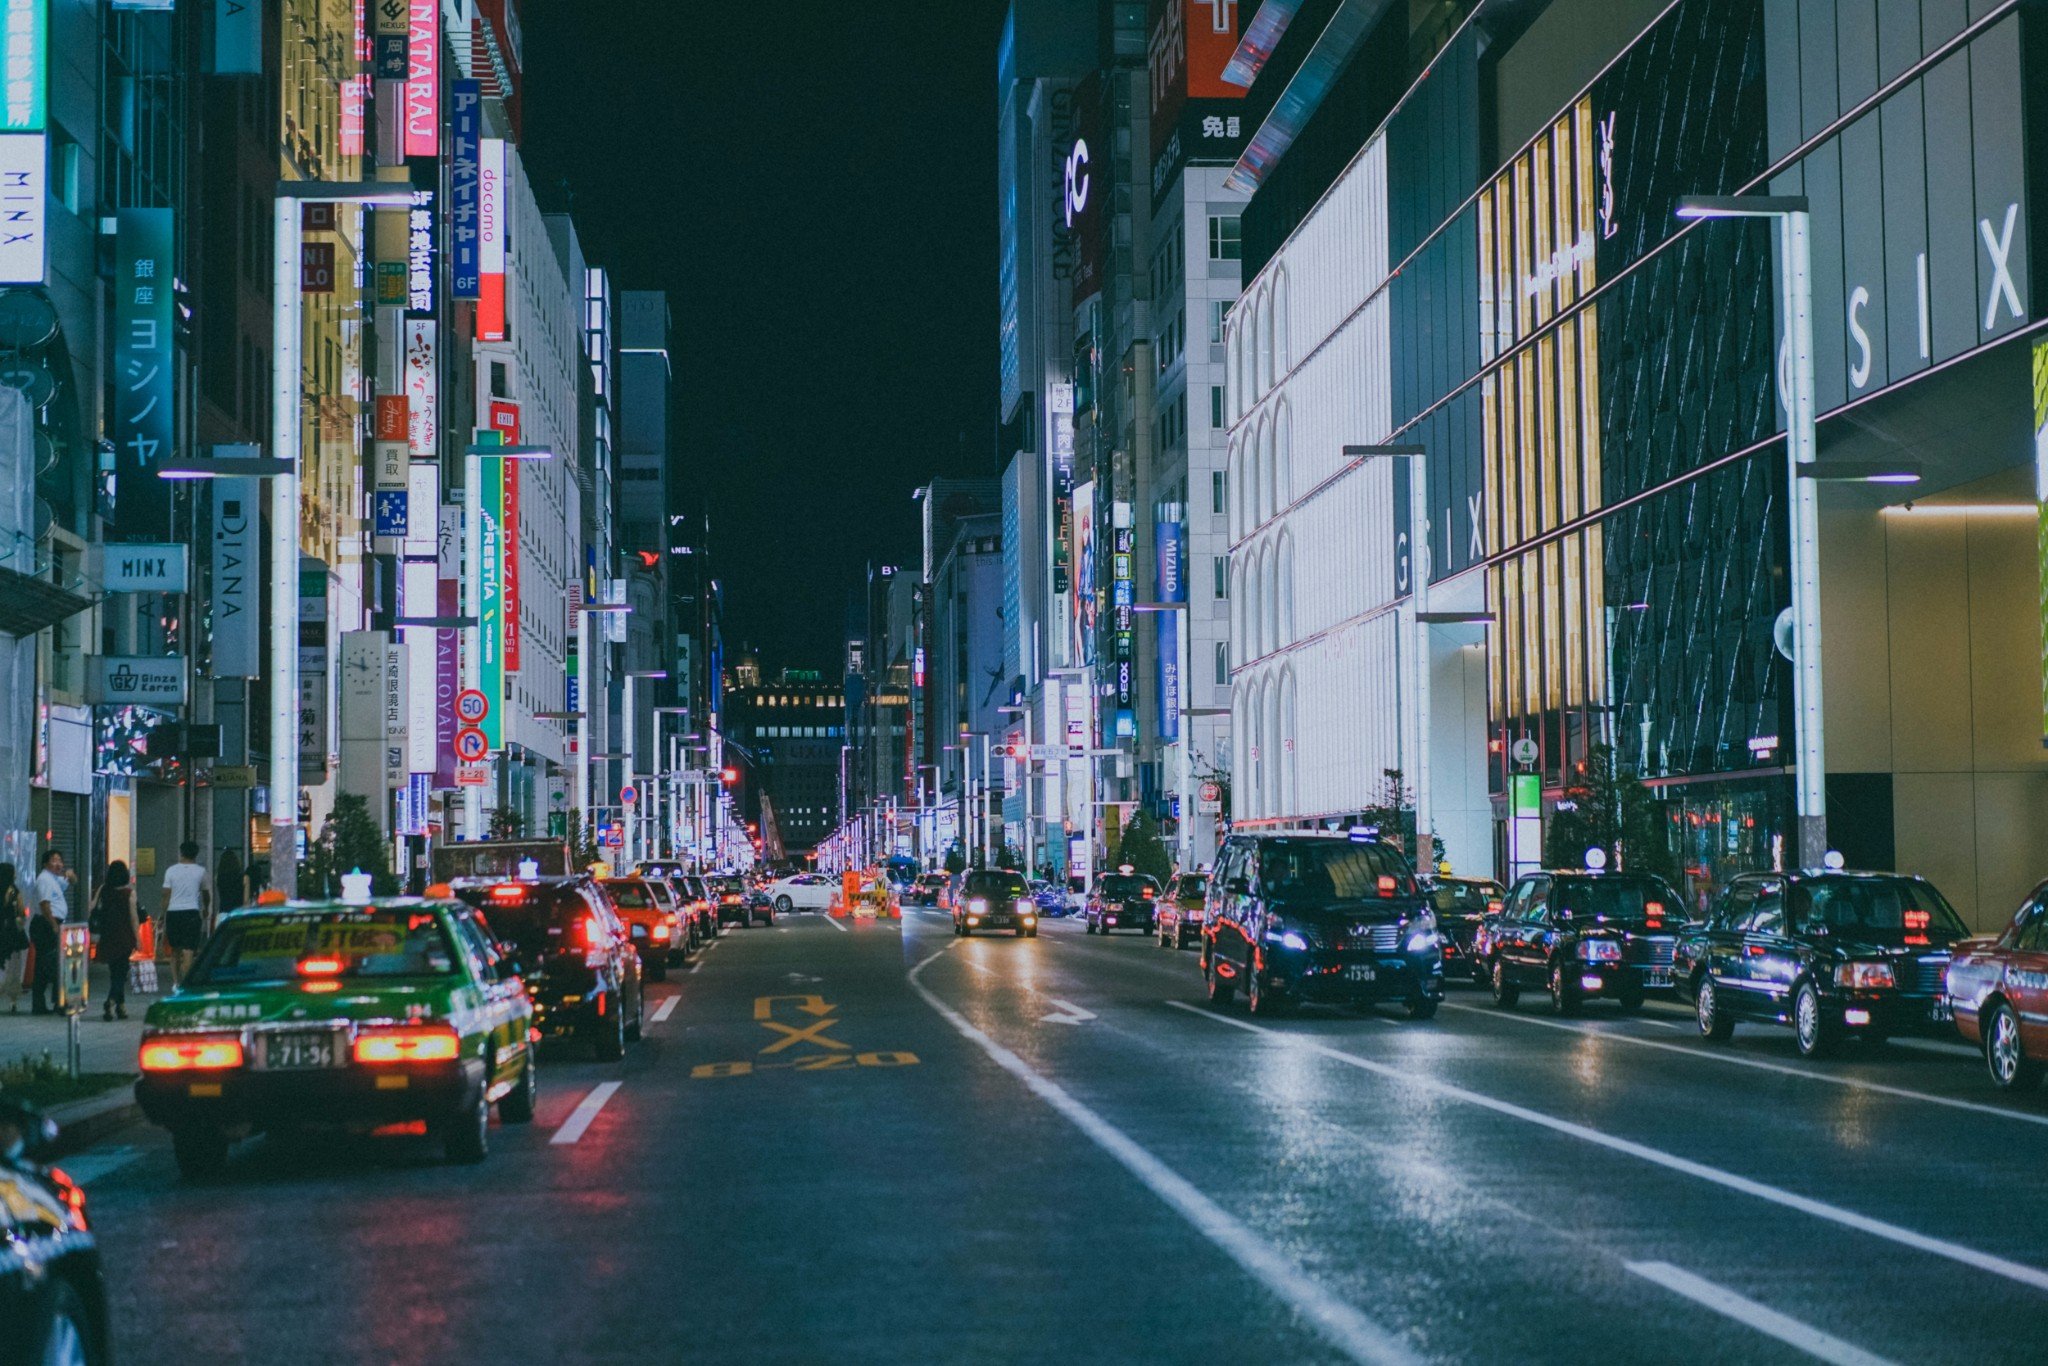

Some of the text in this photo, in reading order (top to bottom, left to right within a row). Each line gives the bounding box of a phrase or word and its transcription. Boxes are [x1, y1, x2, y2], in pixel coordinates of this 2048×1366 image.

[410, 4, 433, 137] NATARAJ
[3, 172, 34, 245] MINX
[484, 169, 498, 242] docomo
[456, 277, 477, 289] 6F
[416, 322, 426, 331] 5F
[386, 449, 399, 476] 買取
[122, 558, 166, 578] MINX
[217, 500, 248, 618] DIANA
[1165, 539, 1177, 592] MIZUHO
[616, 587, 625, 637] TASKI
[141, 684, 178, 692] Karen
[438, 629, 455, 743] DALLOYAU
[1120, 661, 1129, 704] GEOX
[1165, 663, 1177, 721] みずほ銀行
[462, 699, 482, 714] 50
[1522, 742, 1530, 754] 4
